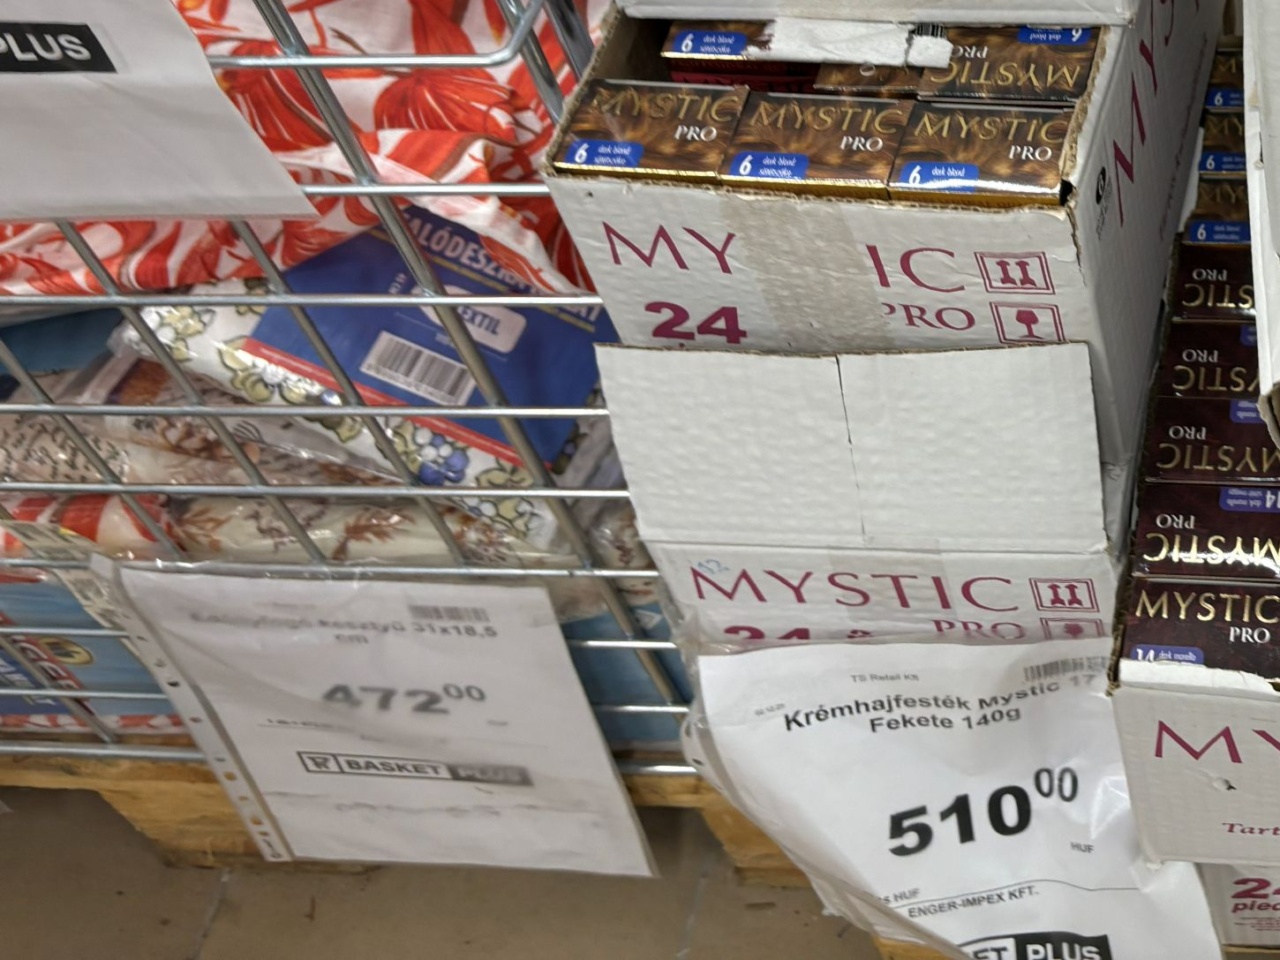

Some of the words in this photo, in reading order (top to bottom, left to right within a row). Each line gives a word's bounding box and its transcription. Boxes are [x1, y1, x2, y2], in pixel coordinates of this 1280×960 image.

[673, 124, 719, 142] PRO
[914, 111, 1068, 142] MYSTIC
[839, 136, 884, 152] PRO
[1008, 144, 1053, 162] PRO
[644, 301, 748, 345] 24
[1155, 513, 1196, 530] PRO
[691, 566, 1020, 612] MYSTIC
[1135, 589, 1280, 624] MYSTIC
[1229, 626, 1271, 644] PRO
[783, 693, 970, 732] Krémhajfesték
[978, 680, 1060, 711] Mystic
[870, 713, 955, 734] Fekete
[961, 706, 1022, 730] 140g
[344, 758, 442, 778] BASKET
[1070, 841, 1095, 854] HUF
